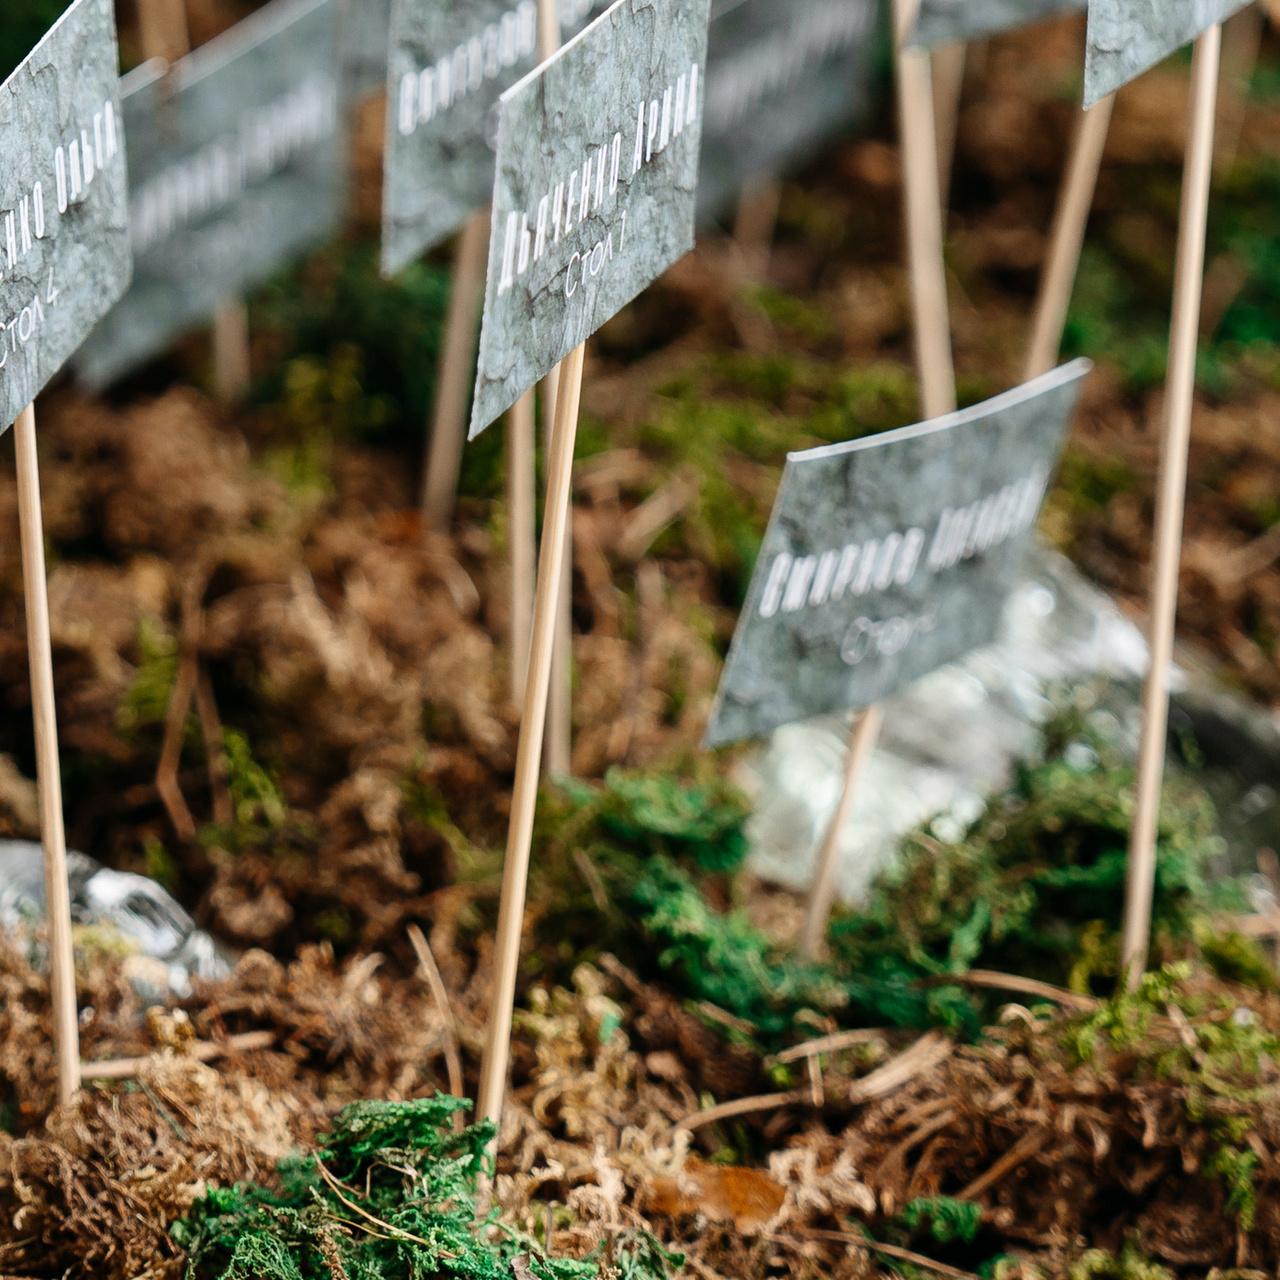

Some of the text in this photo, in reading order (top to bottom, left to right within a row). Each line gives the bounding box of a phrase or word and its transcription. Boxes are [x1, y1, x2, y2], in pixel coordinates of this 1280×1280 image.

[53, 100, 118, 215] ОЛЬГА
[497, 131, 621, 297] ДЬЯЧЕНКО
[632, 63, 699, 175] АРИНА
[617, 210, 628, 253] 1
[46, 266, 60, 309] 4
